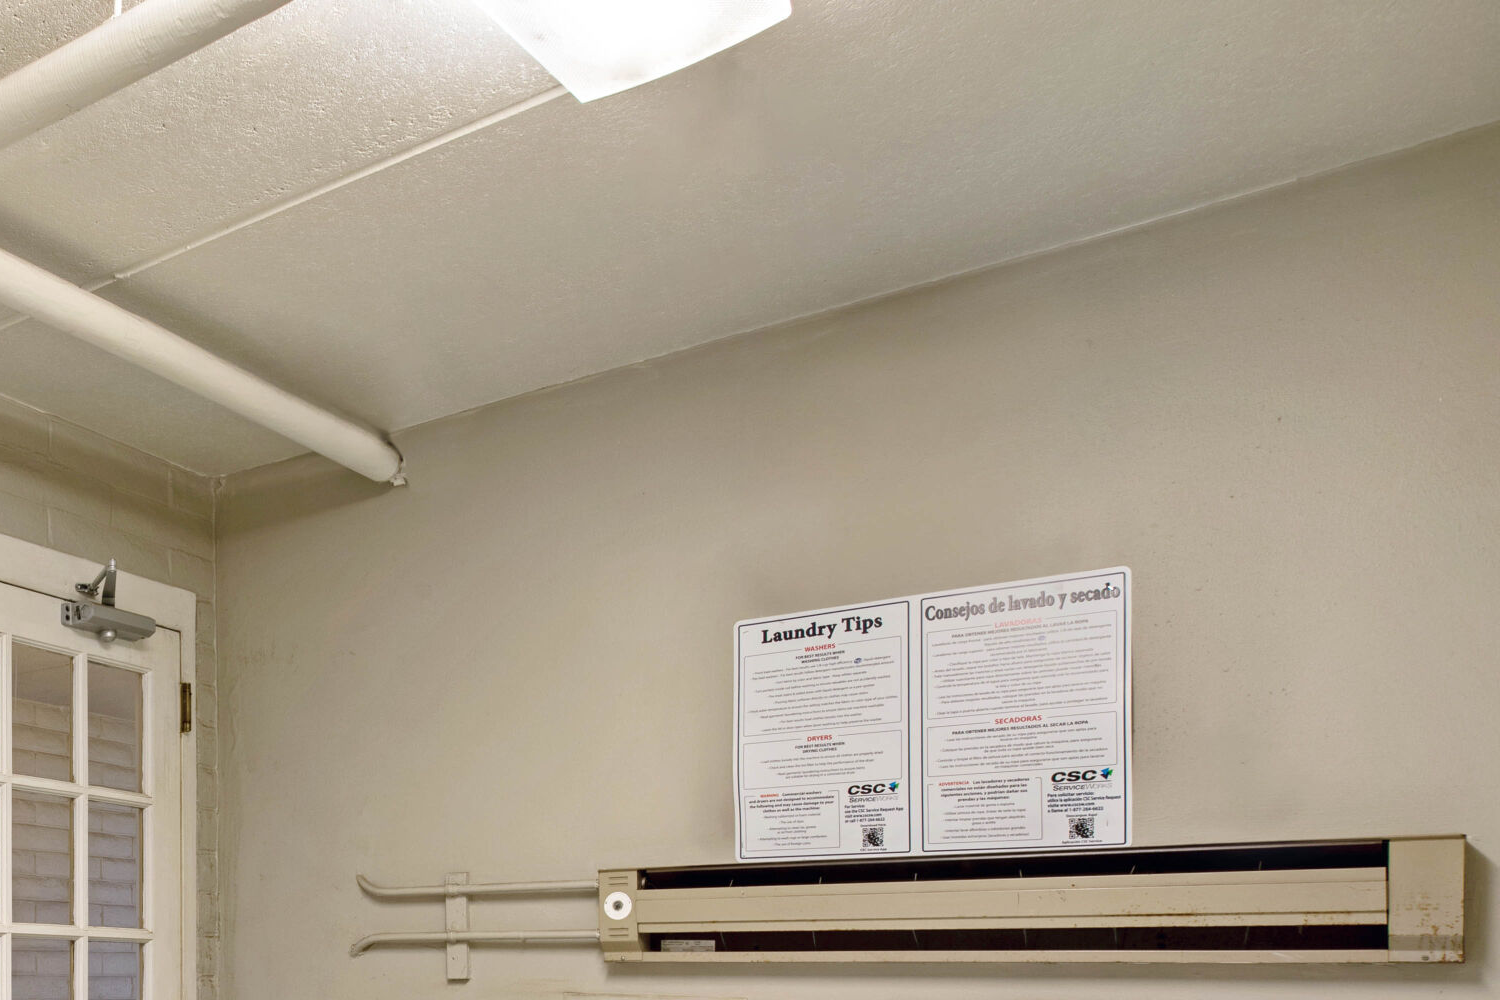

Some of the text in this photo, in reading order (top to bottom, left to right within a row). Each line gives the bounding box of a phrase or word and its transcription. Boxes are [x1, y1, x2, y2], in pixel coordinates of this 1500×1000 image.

[925, 582, 1121, 622] Consejos de lavado y secado
[994, 617, 1042, 629] LAVADORAS
[762, 616, 883, 644] Laundry Tips
[804, 643, 836, 652] WASHERS
[995, 714, 1042, 725] SECADORAS
[807, 734, 833, 742] DRYERS
[1051, 770, 1097, 782] CSC
[848, 784, 886, 795] CSC
